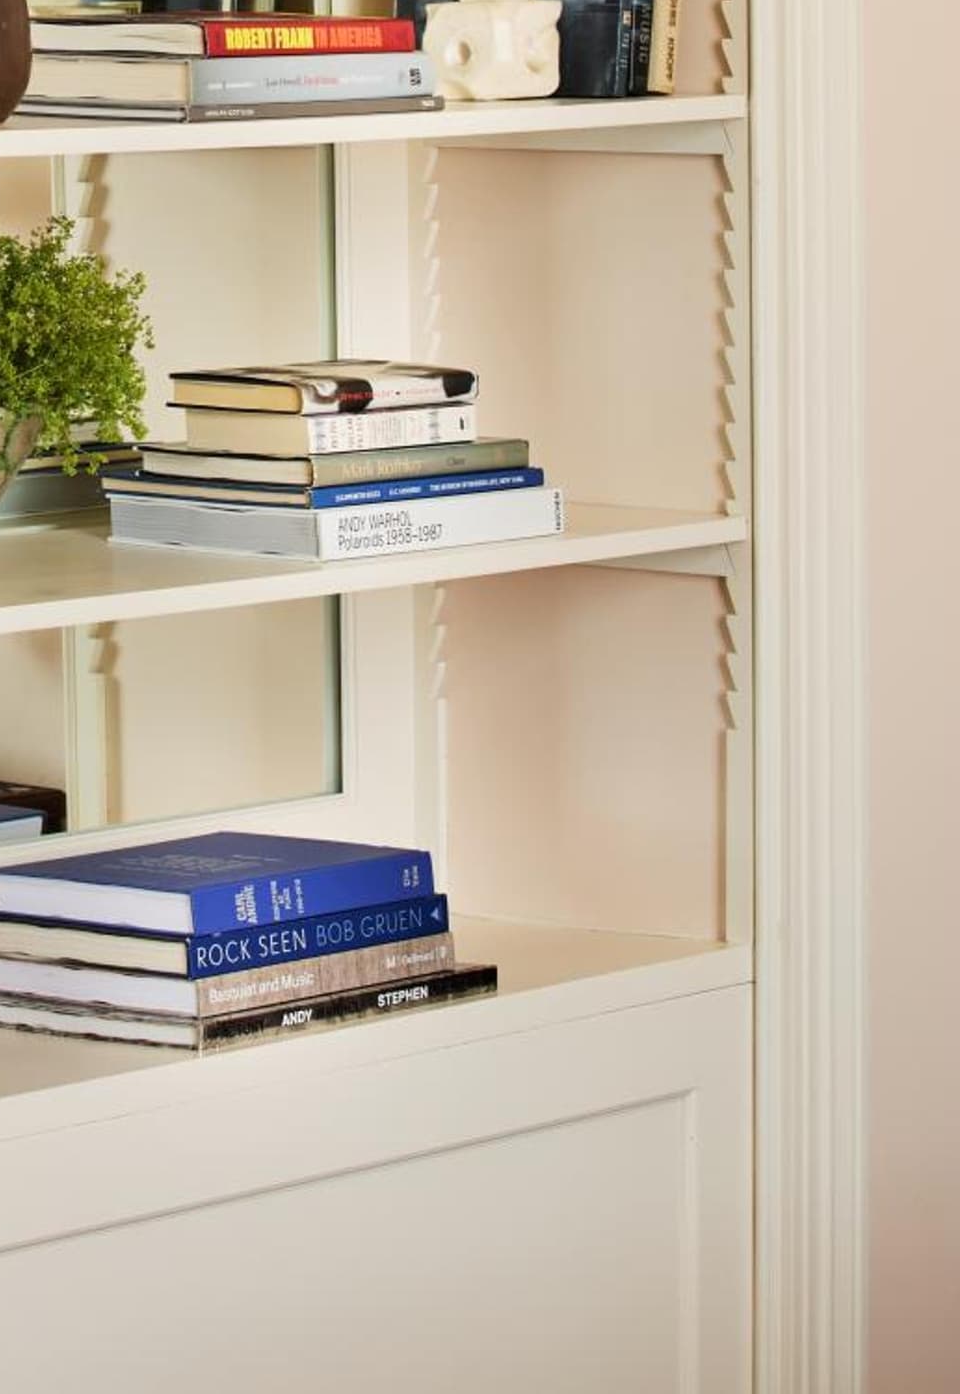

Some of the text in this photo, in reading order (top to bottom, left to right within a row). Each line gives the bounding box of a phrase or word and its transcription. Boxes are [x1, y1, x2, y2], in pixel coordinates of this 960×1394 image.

[225, 27, 273, 50] ROBERT
[274, 26, 314, 49] FRANK
[329, 26, 383, 49] AMERICA
[638, 3, 652, 64] MUSIC
[338, 510, 413, 533] ANDY WARHOL
[338, 532, 385, 551] Polaroids
[196, 907, 424, 969] ROCK SEEN BOB GRUEN
[258, 976, 280, 993] and
[280, 971, 315, 990] Music
[377, 985, 429, 1007] STEPHEN
[281, 1009, 313, 1027] ANDY
